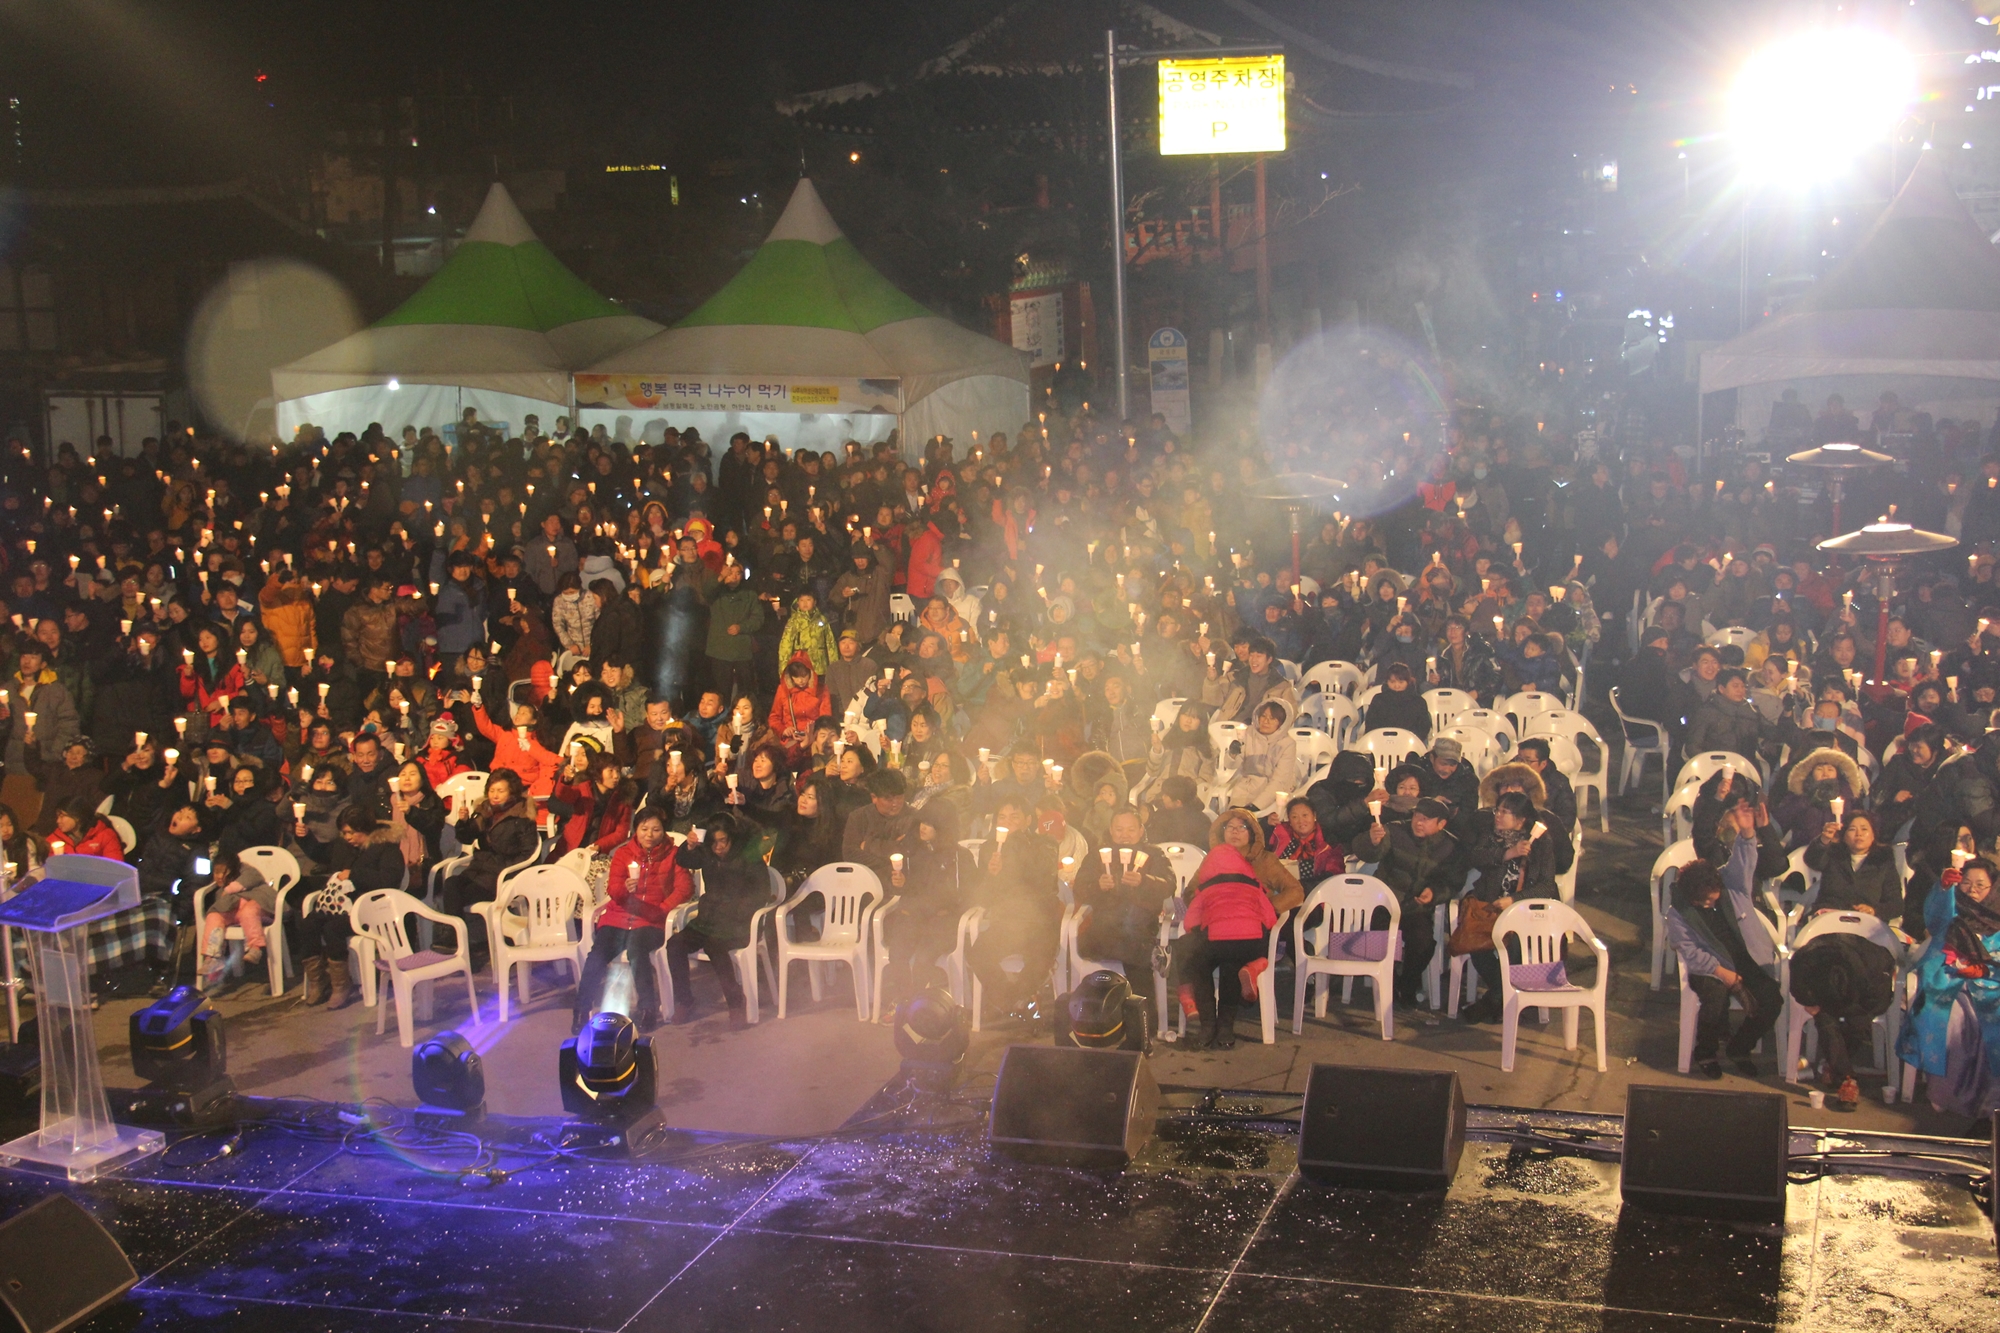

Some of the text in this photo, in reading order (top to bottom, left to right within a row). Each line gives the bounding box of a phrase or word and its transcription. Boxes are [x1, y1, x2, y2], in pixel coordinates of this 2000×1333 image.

[1165, 68, 1277, 92] 공영주차장
[1211, 121, 1228, 138] P
[640, 382, 667, 398] 행복
[673, 383, 702, 398] 떡국
[708, 383, 751, 399] 나누어
[758, 384, 786, 399] 먹기
